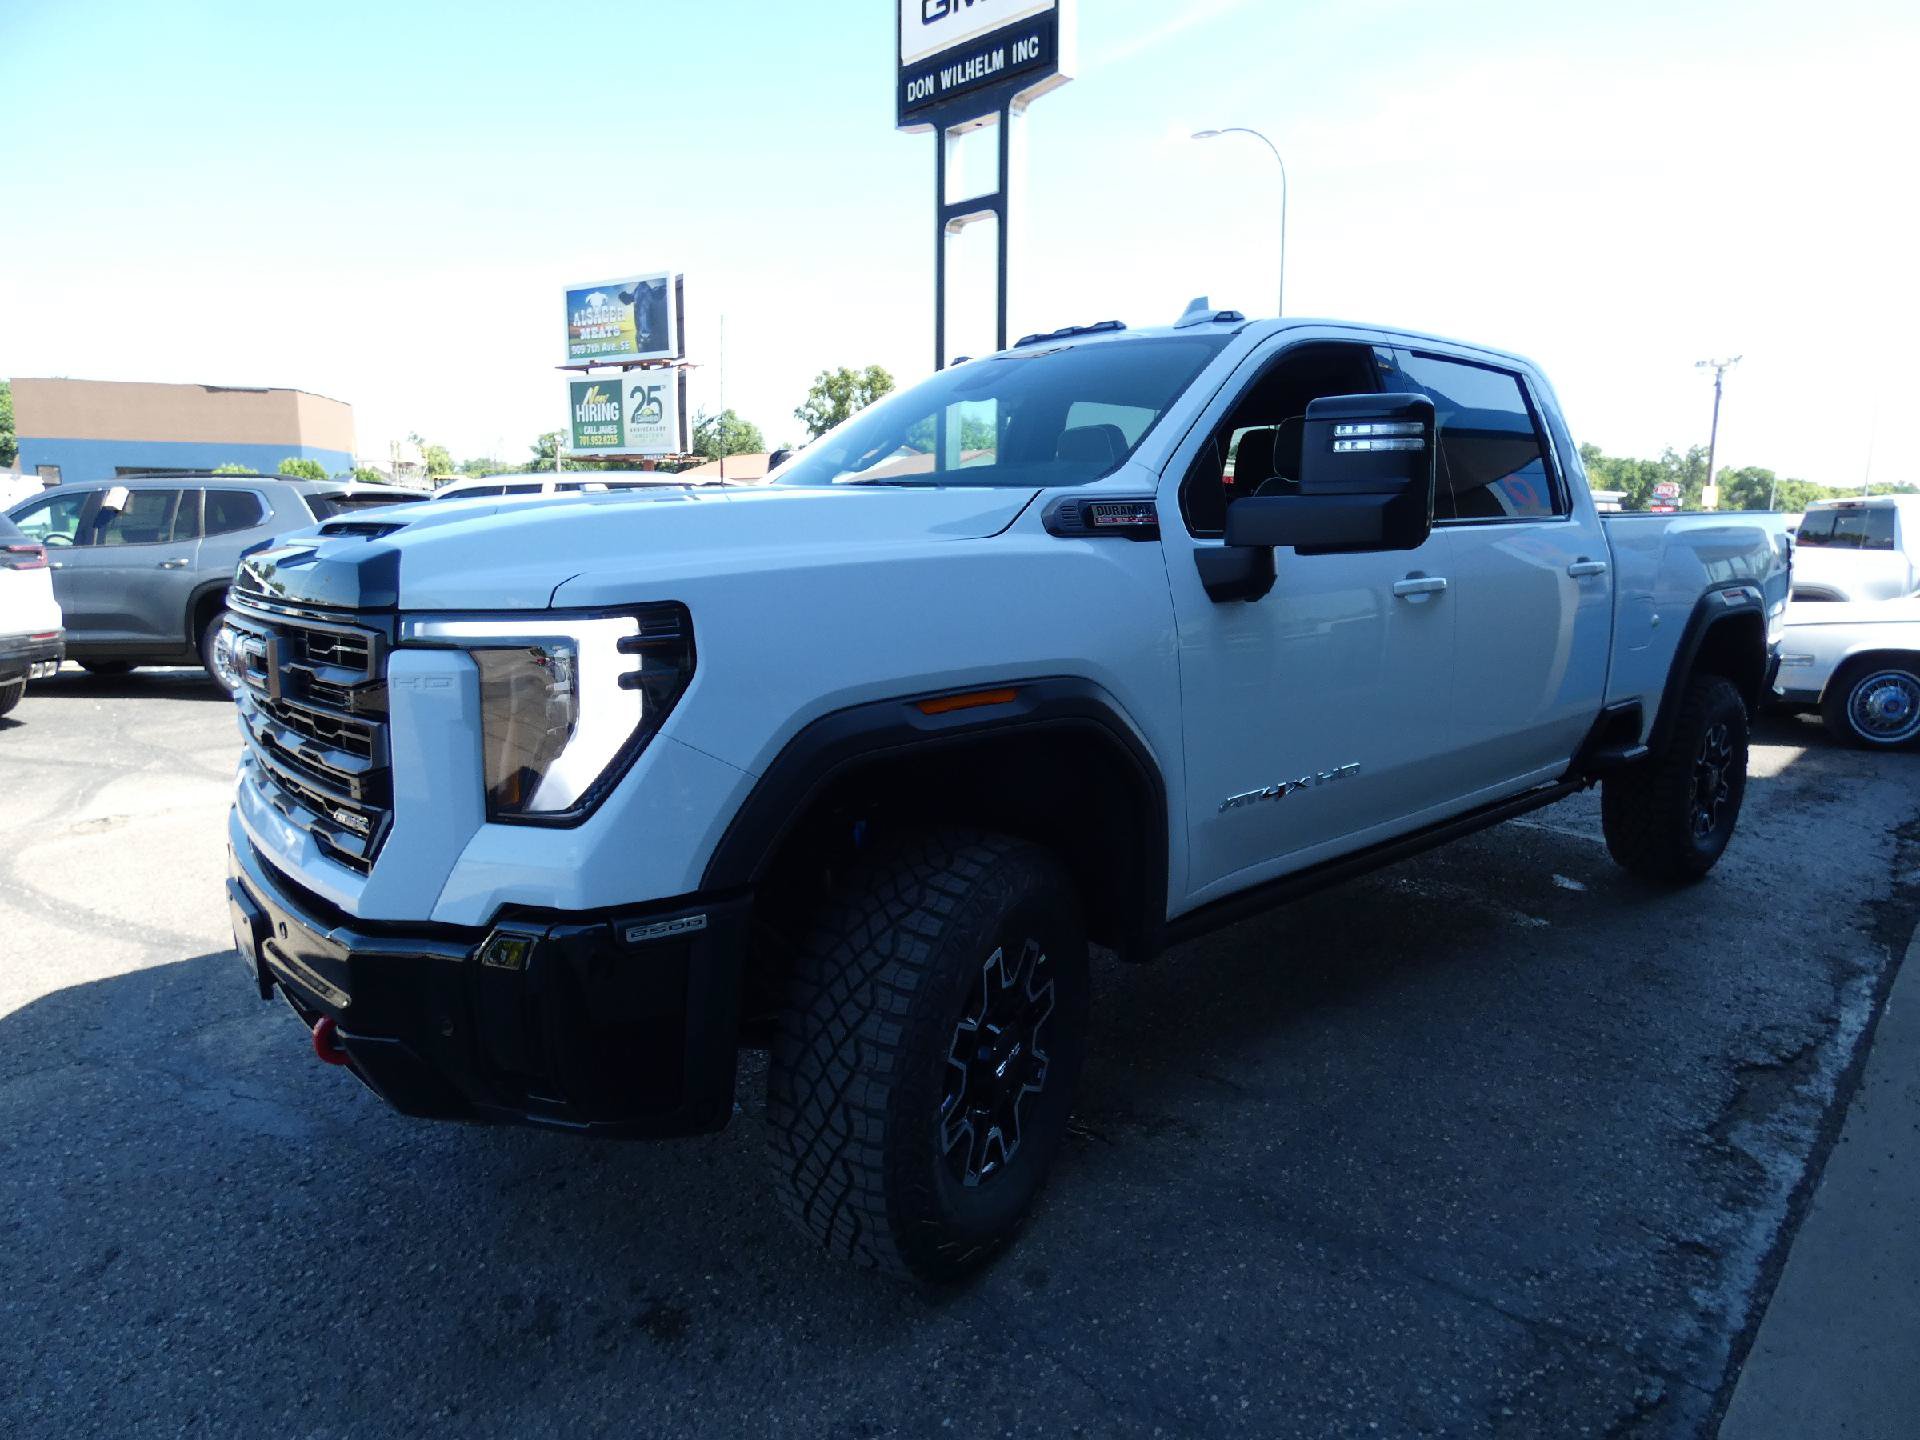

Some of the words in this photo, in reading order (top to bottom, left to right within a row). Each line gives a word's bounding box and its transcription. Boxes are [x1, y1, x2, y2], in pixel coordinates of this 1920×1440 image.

[907, 75, 935, 102] DON
[941, 48, 1004, 90] WILHELM
[1012, 35, 1039, 65] INC
[580, 326, 621, 339] MEATS
[576, 401, 620, 423] HIRING
[629, 385, 663, 424] 25
